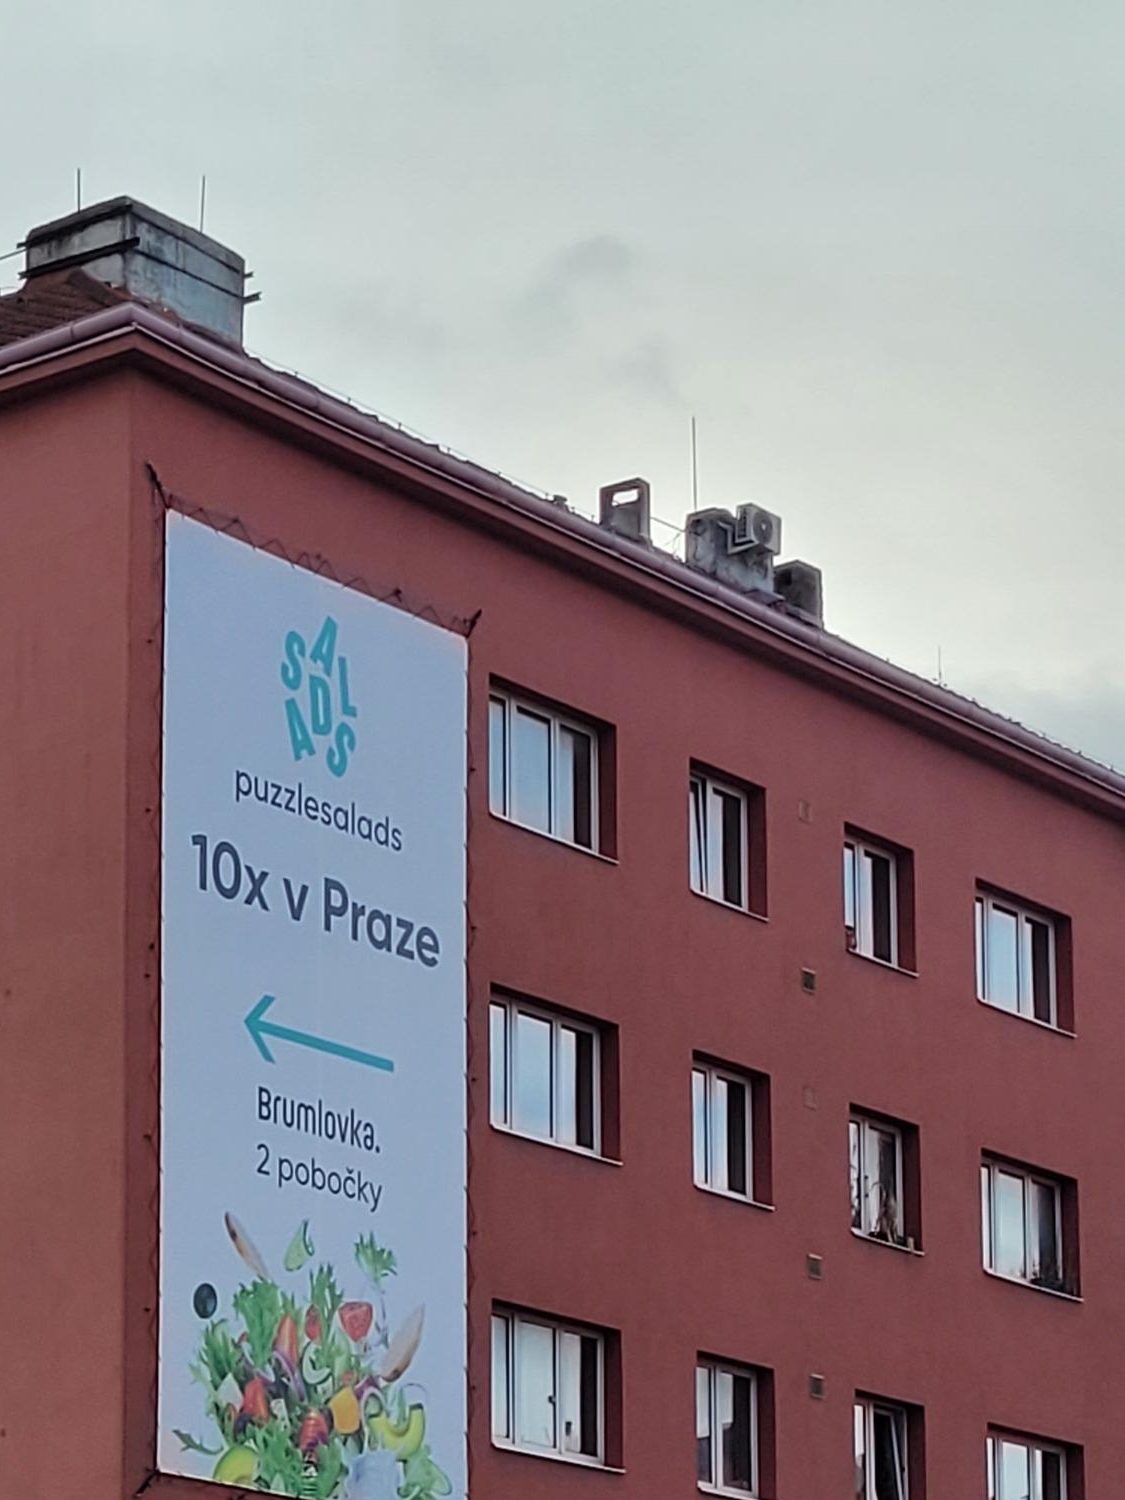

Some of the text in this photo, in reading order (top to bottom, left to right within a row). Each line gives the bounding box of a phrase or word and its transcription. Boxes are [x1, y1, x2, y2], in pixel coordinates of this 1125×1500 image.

[235, 769, 403, 852] puzzlesalads
[191, 834, 441, 968] 10x v Praze
[258, 1085, 381, 1154] Brumlovka.
[256, 1143, 383, 1214] 2 pobočky
